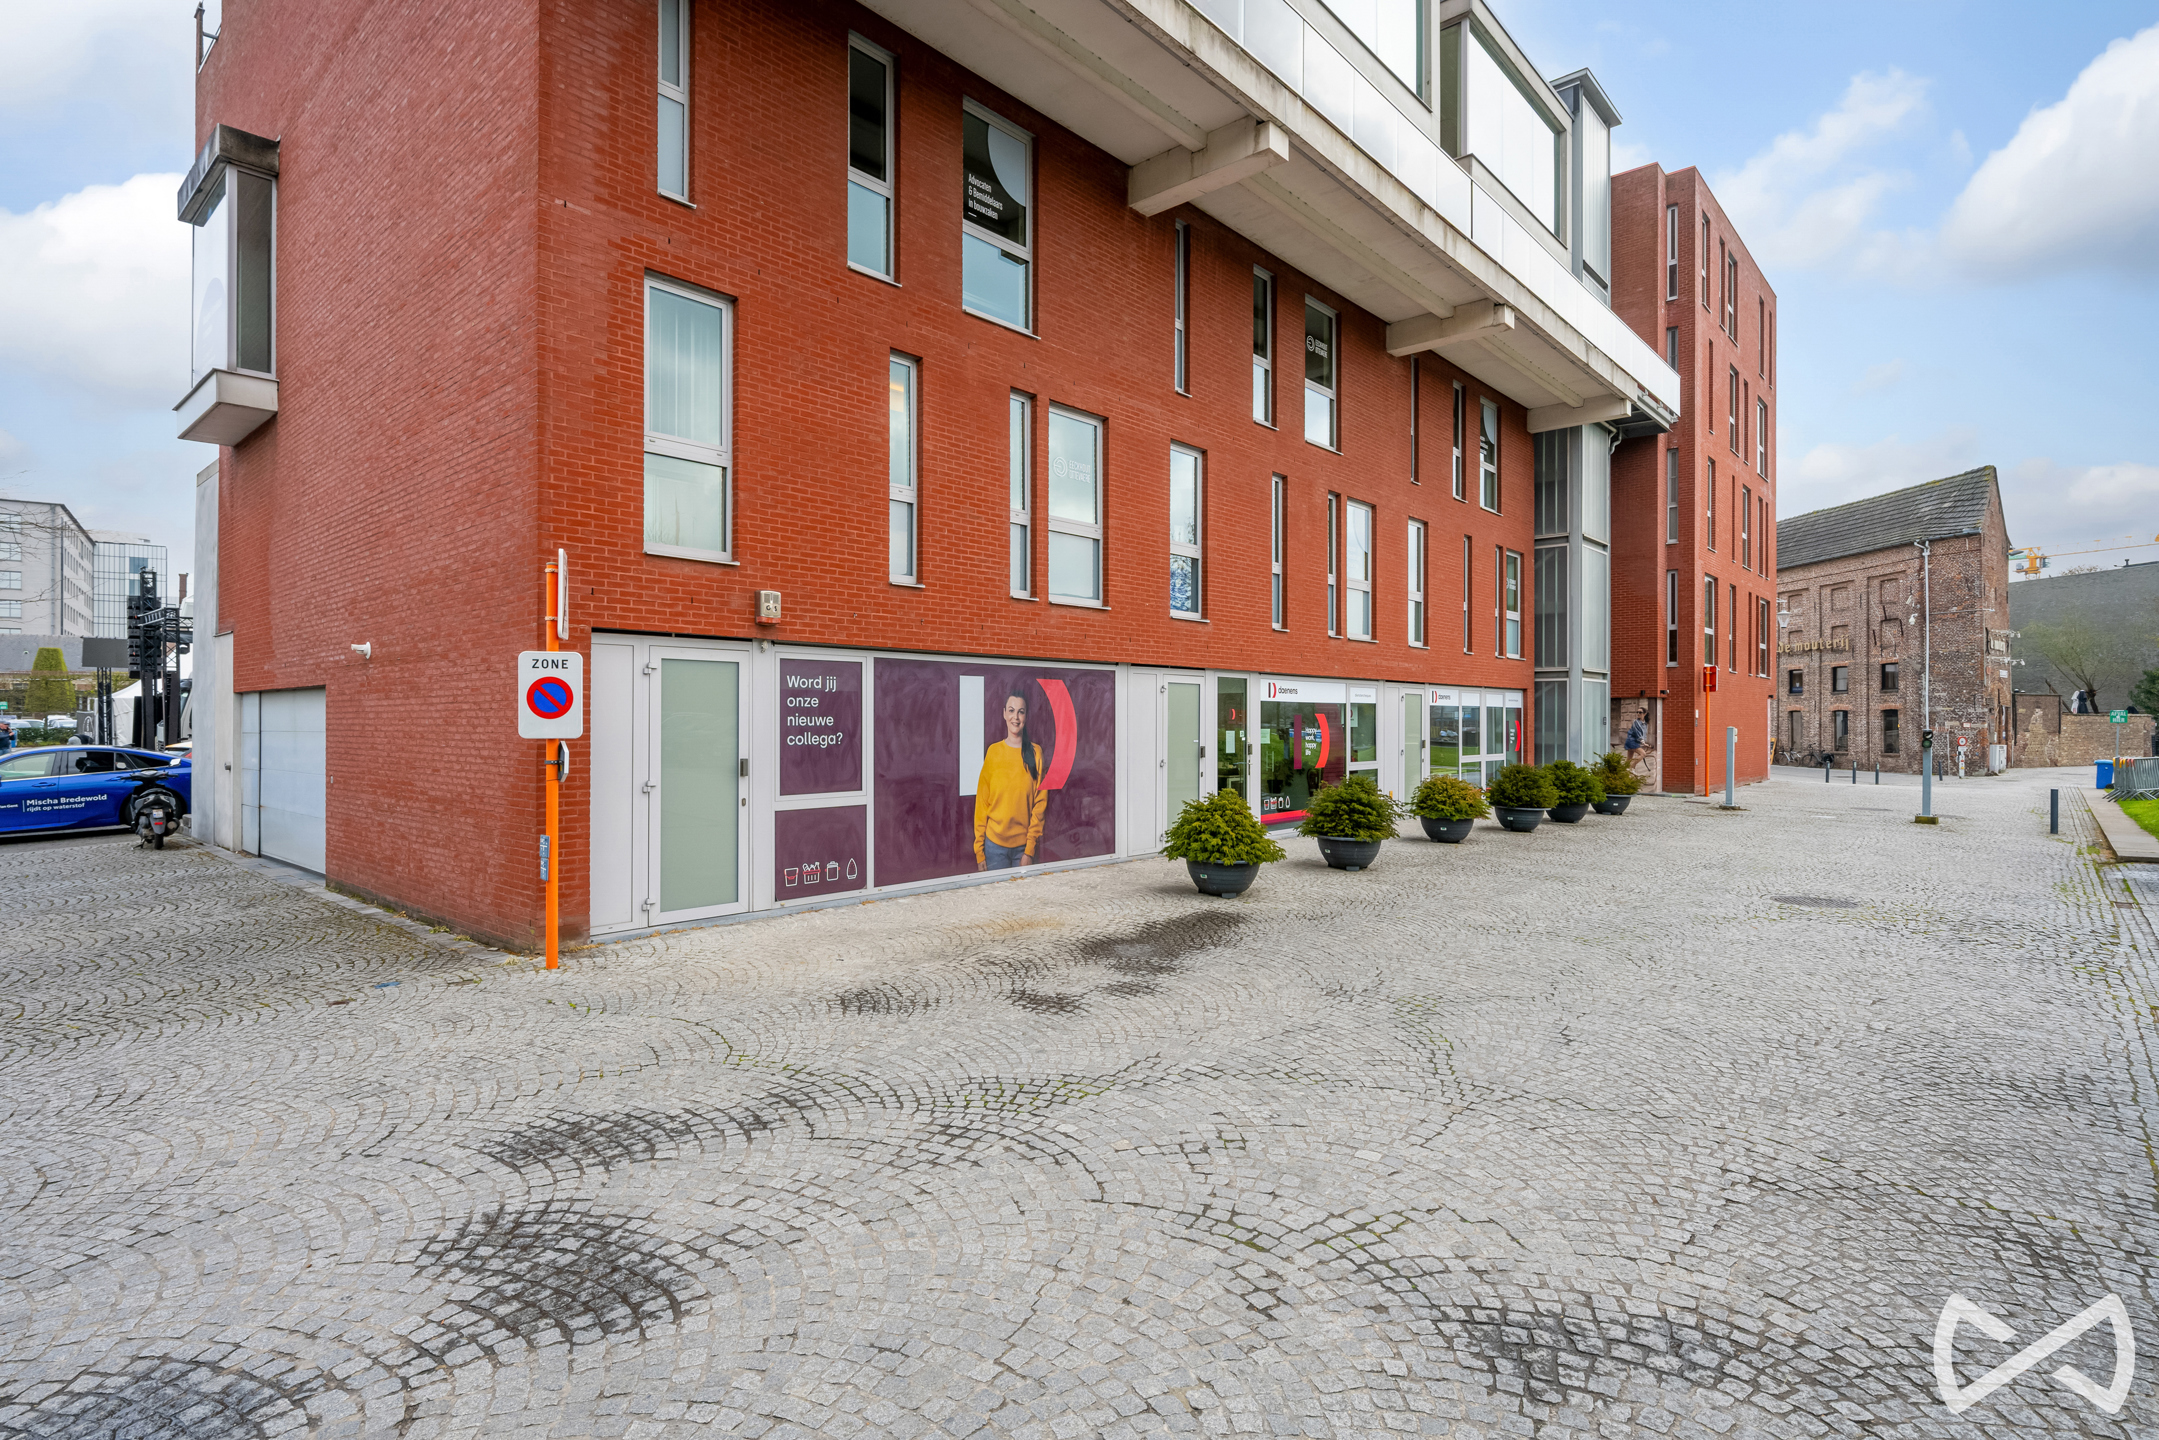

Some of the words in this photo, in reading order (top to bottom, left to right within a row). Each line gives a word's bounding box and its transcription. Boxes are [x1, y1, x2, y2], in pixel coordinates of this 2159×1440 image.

[968, 173, 992, 193] Advocaten
[973, 187, 1003, 210] Bemiddelaars
[973, 199, 999, 220] bouwzaken
[1776, 641, 1791, 654] de
[1795, 634, 1850, 652] mouterij
[531, 658, 569, 669] ZONE
[786, 675, 822, 689] Word
[825, 676, 837, 692] jij
[1278, 686, 1298, 695] daenens
[786, 697, 819, 707] onze
[787, 713, 834, 726] nieuwe
[786, 731, 843, 748] collega?
[26, 798, 58, 806] Mischa
[60, 794, 107, 803] Bredewold
[53, 802, 85, 810] waterstof
